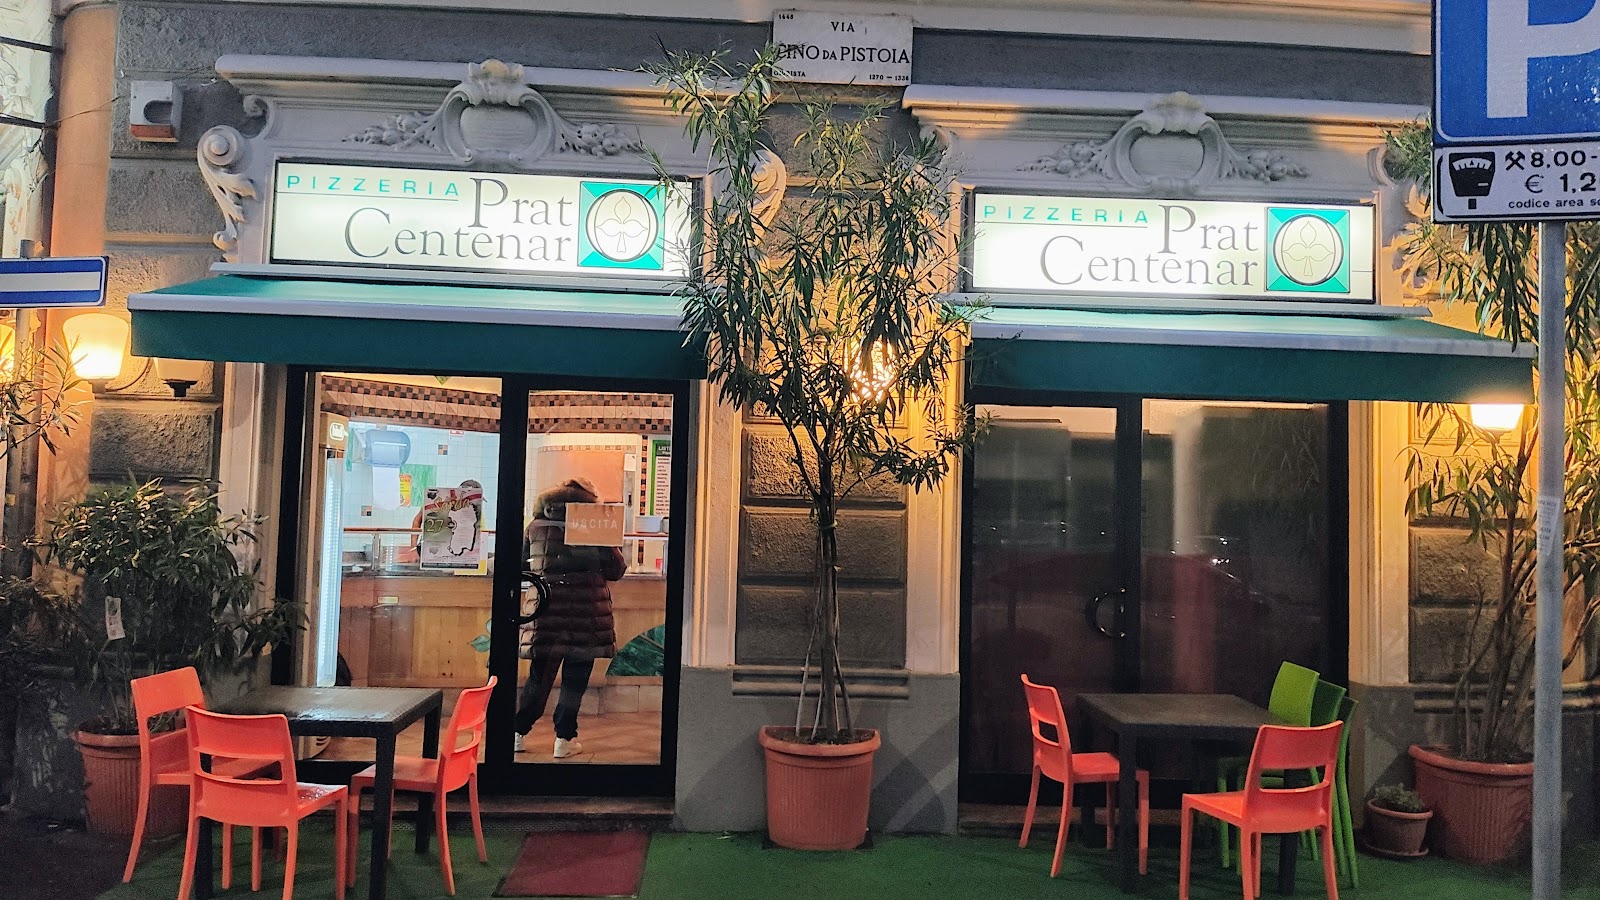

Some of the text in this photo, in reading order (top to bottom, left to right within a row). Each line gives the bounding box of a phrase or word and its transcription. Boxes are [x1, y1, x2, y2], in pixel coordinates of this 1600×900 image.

[831, 21, 855, 33] VIA
[778, 43, 910, 64] CINO DA PISTOIA
[287, 175, 459, 196] PIZZERIA
[468, 177, 573, 229] Prat
[1508, 198, 1550, 208] codice
[1555, 199, 1584, 207] area
[984, 205, 1148, 224] PIZZERIA
[344, 207, 572, 262] Centenar
[1158, 204, 1259, 254] Prat
[1040, 235, 1259, 287] Centenar
[572, 518, 618, 529] USCITA
